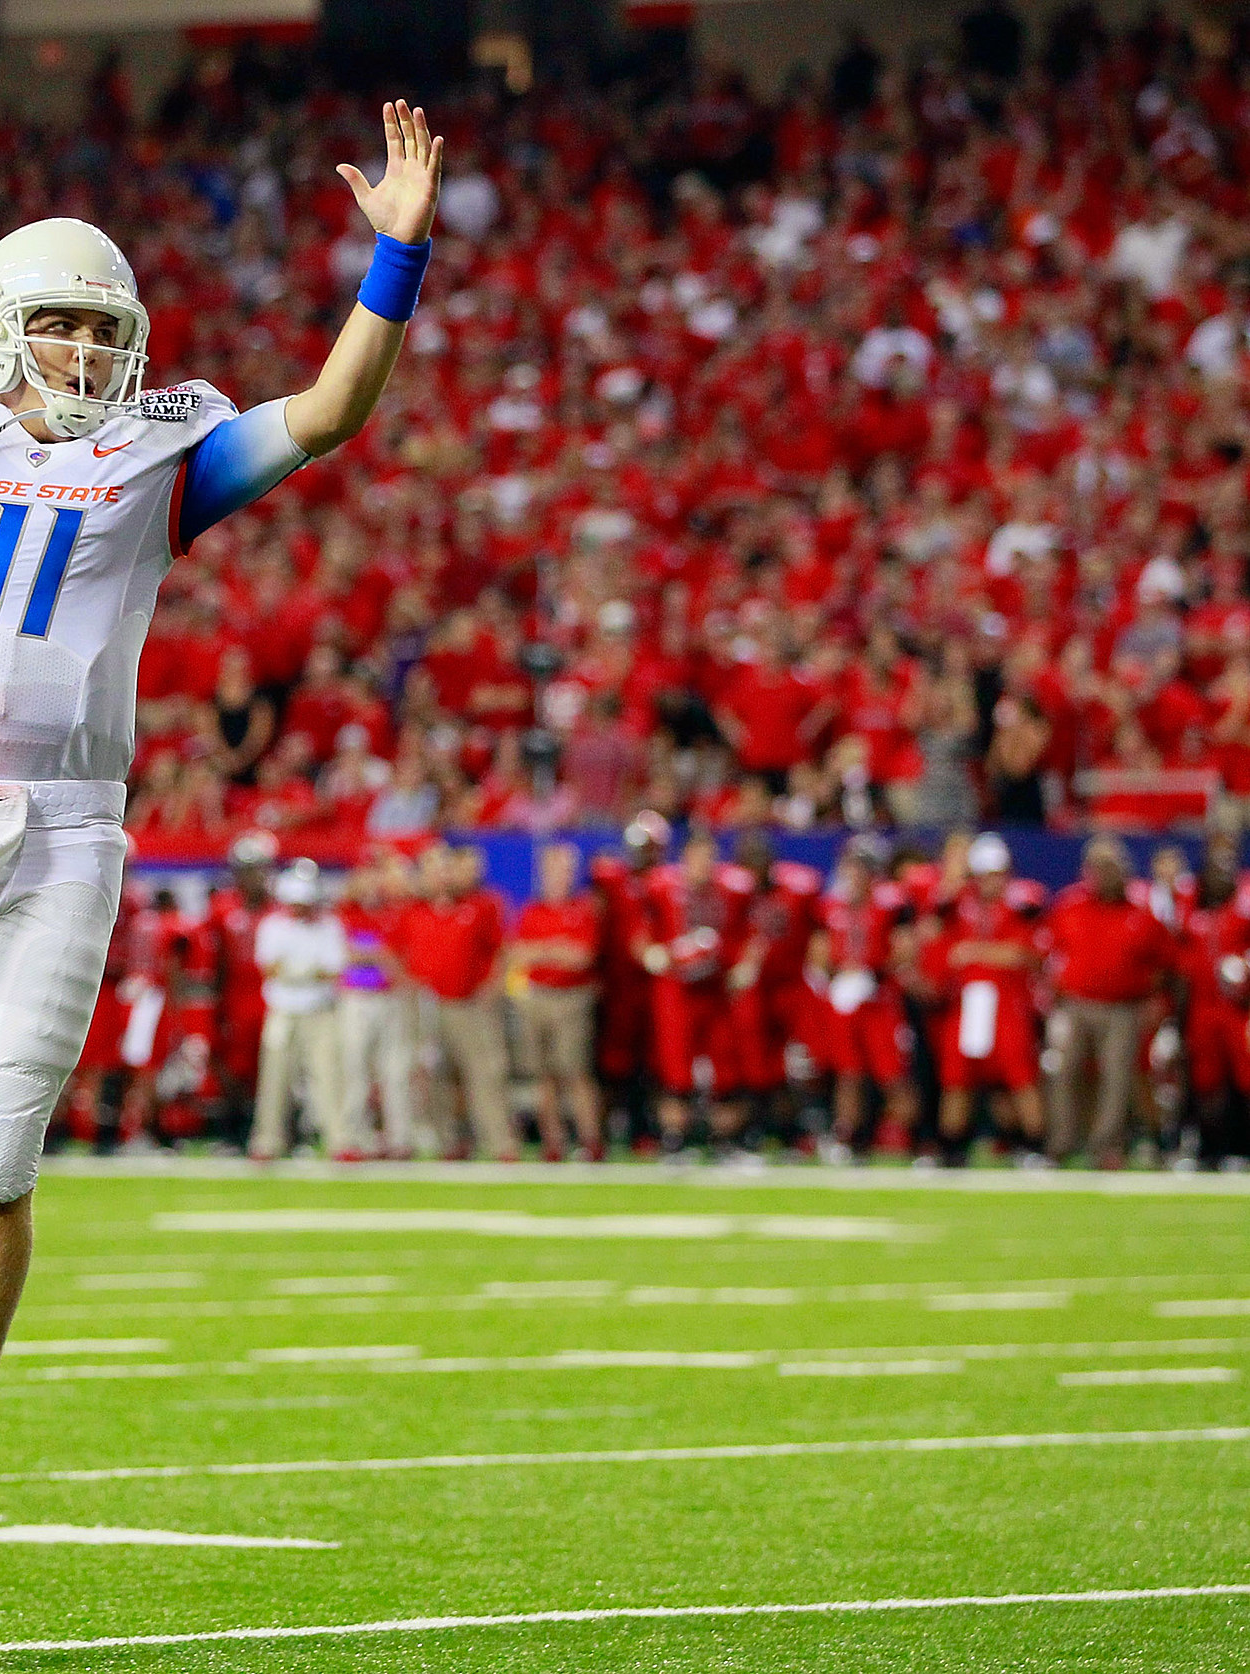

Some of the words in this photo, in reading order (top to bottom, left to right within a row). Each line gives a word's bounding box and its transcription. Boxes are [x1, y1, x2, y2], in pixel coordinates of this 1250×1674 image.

[139, 393, 200, 408] ICKOFF
[142, 404, 186, 415] GAME
[36, 484, 124, 503] STATE
